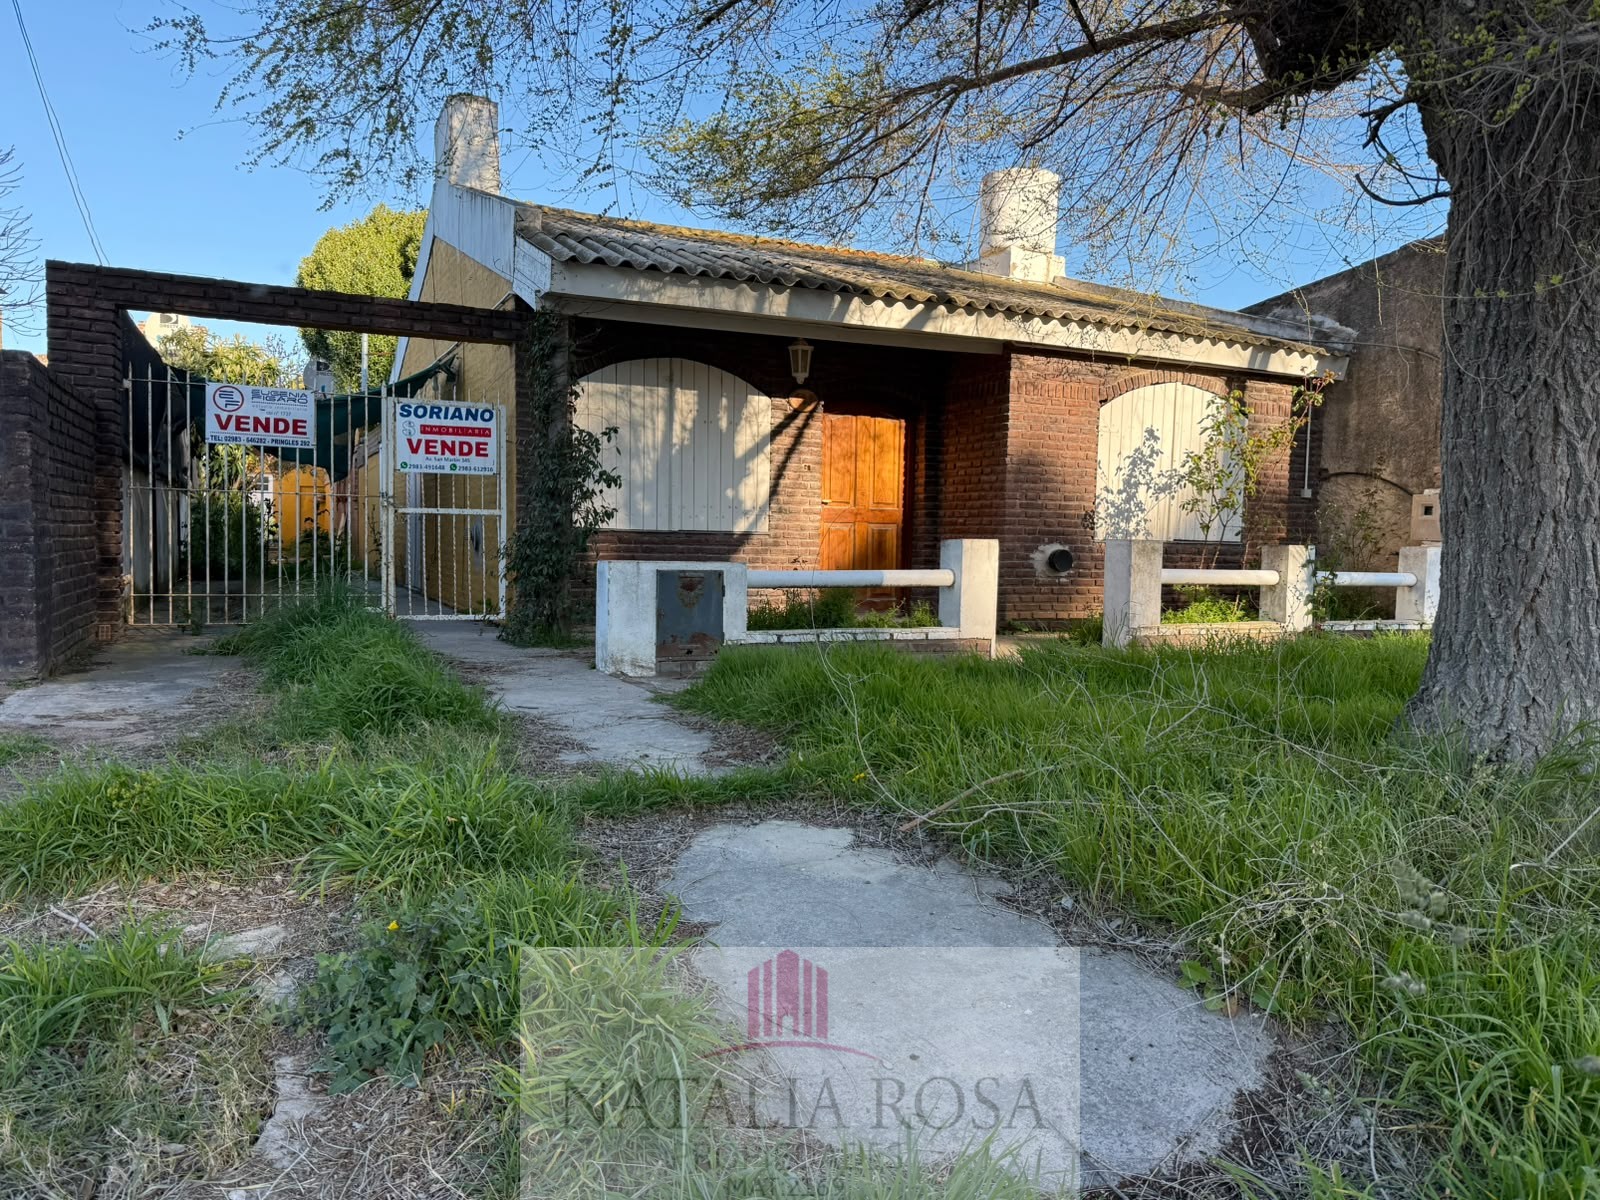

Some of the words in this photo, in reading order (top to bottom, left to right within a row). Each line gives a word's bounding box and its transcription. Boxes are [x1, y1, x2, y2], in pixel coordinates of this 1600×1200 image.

[252, 389, 308, 398] EUGENIA
[252, 396, 308, 404] FIGARO
[398, 404, 494, 422] SORIANO
[214, 414, 308, 436] VENDE
[421, 426, 490, 436] INMOBILIARIA
[270, 438, 299, 446] PRINGLES
[406, 438, 488, 457] VENDE
